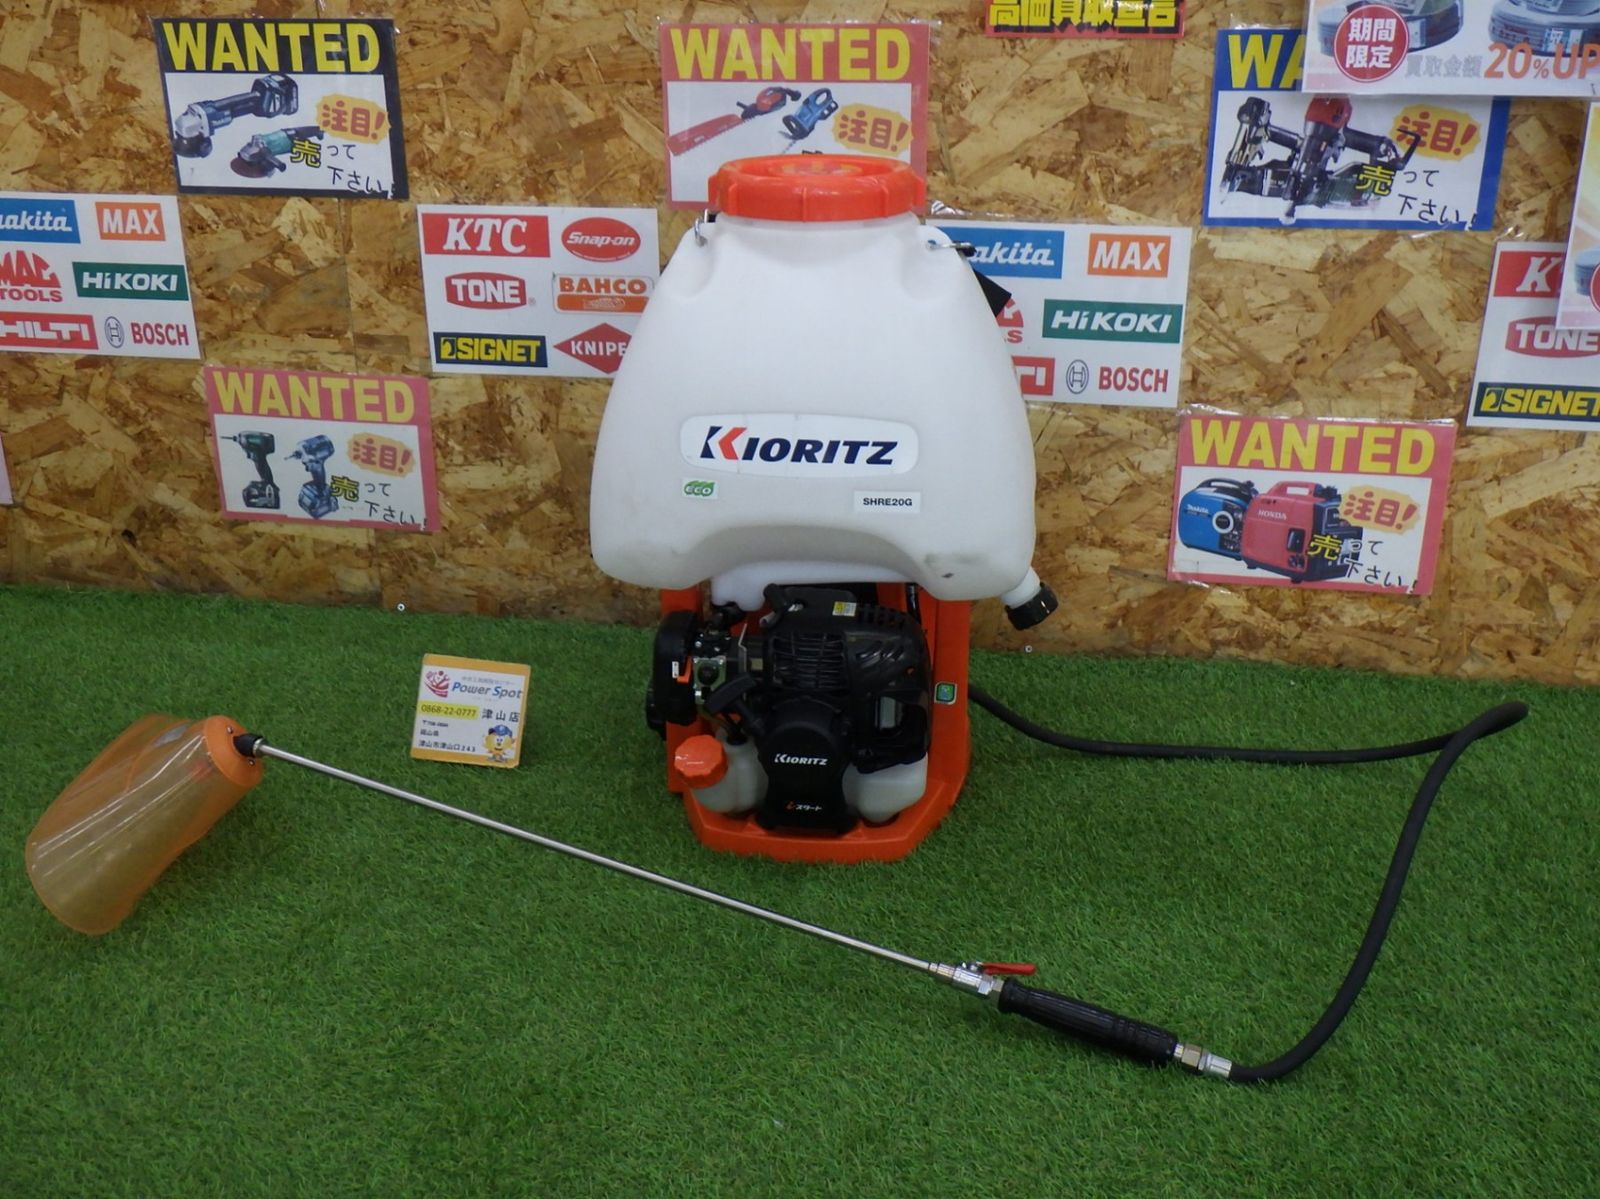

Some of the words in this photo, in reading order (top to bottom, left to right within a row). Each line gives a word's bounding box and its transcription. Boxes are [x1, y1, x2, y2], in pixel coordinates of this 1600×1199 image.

[1348, 18, 1397, 42] 期間
[162, 22, 380, 73] WANTED
[670, 28, 911, 81] WANTED
[1345, 45, 1393, 69] 限定
[0, 211, 73, 232] akita
[102, 208, 161, 235] MAX
[442, 218, 528, 254] KTC
[566, 231, 636, 248] Snap-on
[967, 241, 1055, 266] akita
[1092, 241, 1166, 271] MAX
[82, 272, 178, 292] HiKOKI
[559, 276, 647, 295] BAHCO
[1516, 256, 1562, 293] K
[450, 278, 521, 304] TONE
[0, 320, 91, 342] HILTI
[1051, 309, 1173, 334] HiKOKI
[130, 322, 190, 346] BOSCH
[1515, 323, 1599, 352] TONE
[456, 338, 541, 362] SIGNET
[1098, 366, 1169, 392] BOSCH
[213, 371, 415, 423] WANTED
[700, 426, 898, 465] KIORITZ
[1190, 419, 1436, 475] WANTED
[862, 497, 913, 507] SHRE20G
[1258, 509, 1287, 520] HONDA
[452, 682, 491, 695] Power
[492, 686, 523, 699] Spot
[421, 704, 477, 717] 0868-22-0777
[482, 708, 520, 723] 津山店
[774, 753, 829, 766] KIORITZ
